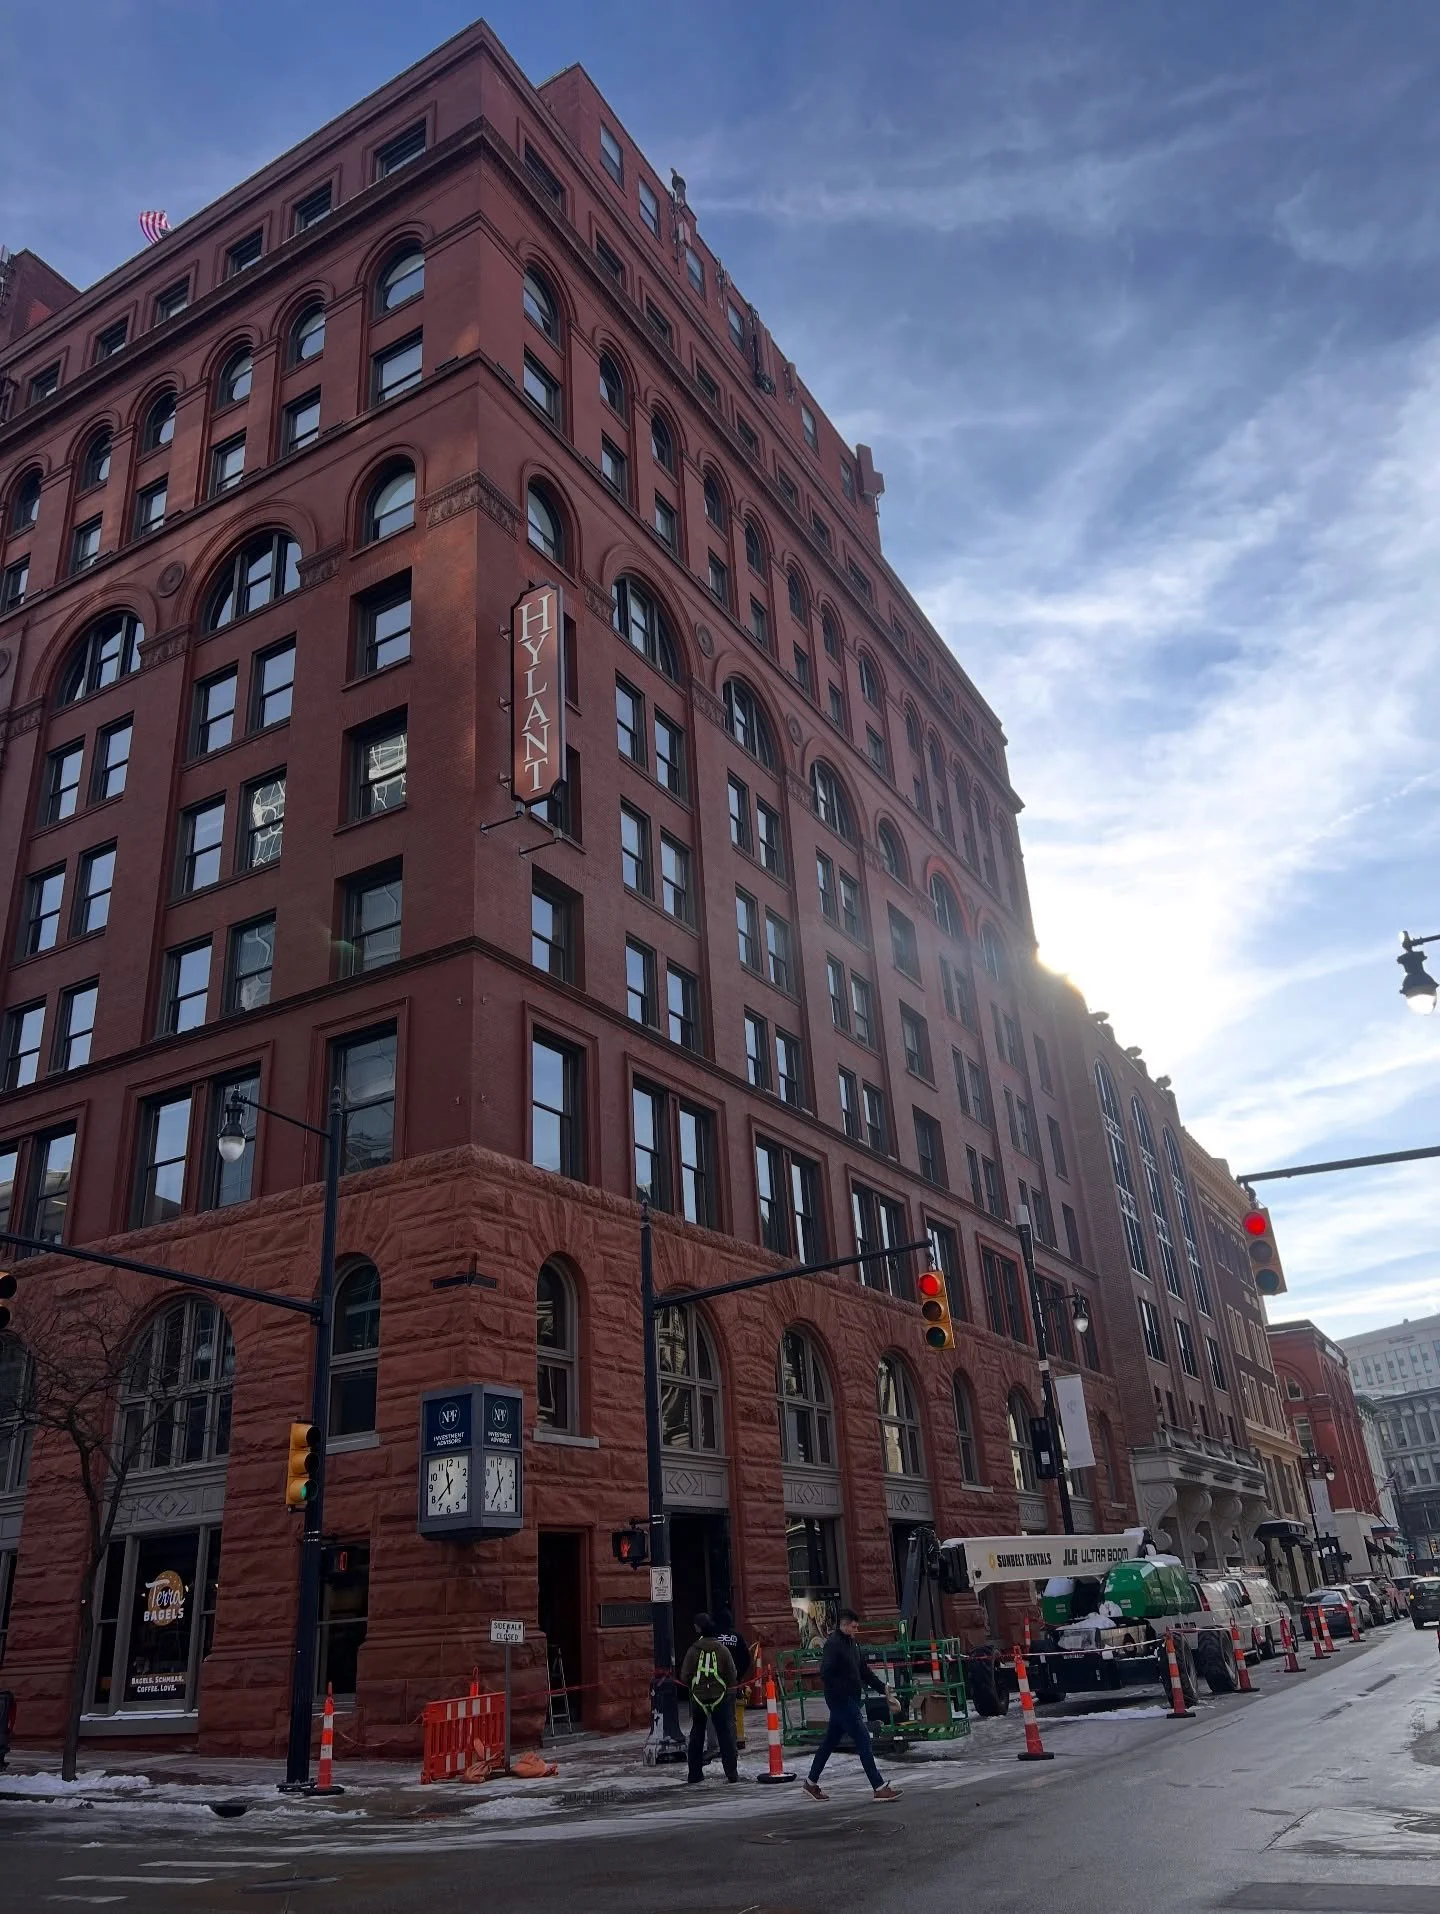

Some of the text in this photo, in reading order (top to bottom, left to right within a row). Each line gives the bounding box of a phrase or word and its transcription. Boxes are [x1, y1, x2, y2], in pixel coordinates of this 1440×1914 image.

[518, 593, 552, 792] HYLANT
[441, 1409, 458, 1424] NPF
[494, 1407, 507, 1422] NPF
[433, 1431, 465, 1442] INVESTMENT
[488, 1431, 513, 1439] INVESTMENT
[491, 1436, 510, 1444] ADVISORS
[436, 1438, 462, 1447] ADVISORS
[430, 1472, 438, 1482] 10
[996, 1552, 1052, 1567] SUNBELT RENTALS
[1063, 1547, 1129, 1566] JLG ULTRA BOOM
[145, 1579, 185, 1608] Terra
[143, 1608, 185, 1622] BAGELS
[493, 1622, 522, 1630] SIDEWALK
[496, 1633, 519, 1641] CLOSED
[136, 1684, 177, 1693] COFFEE. LOVE.
